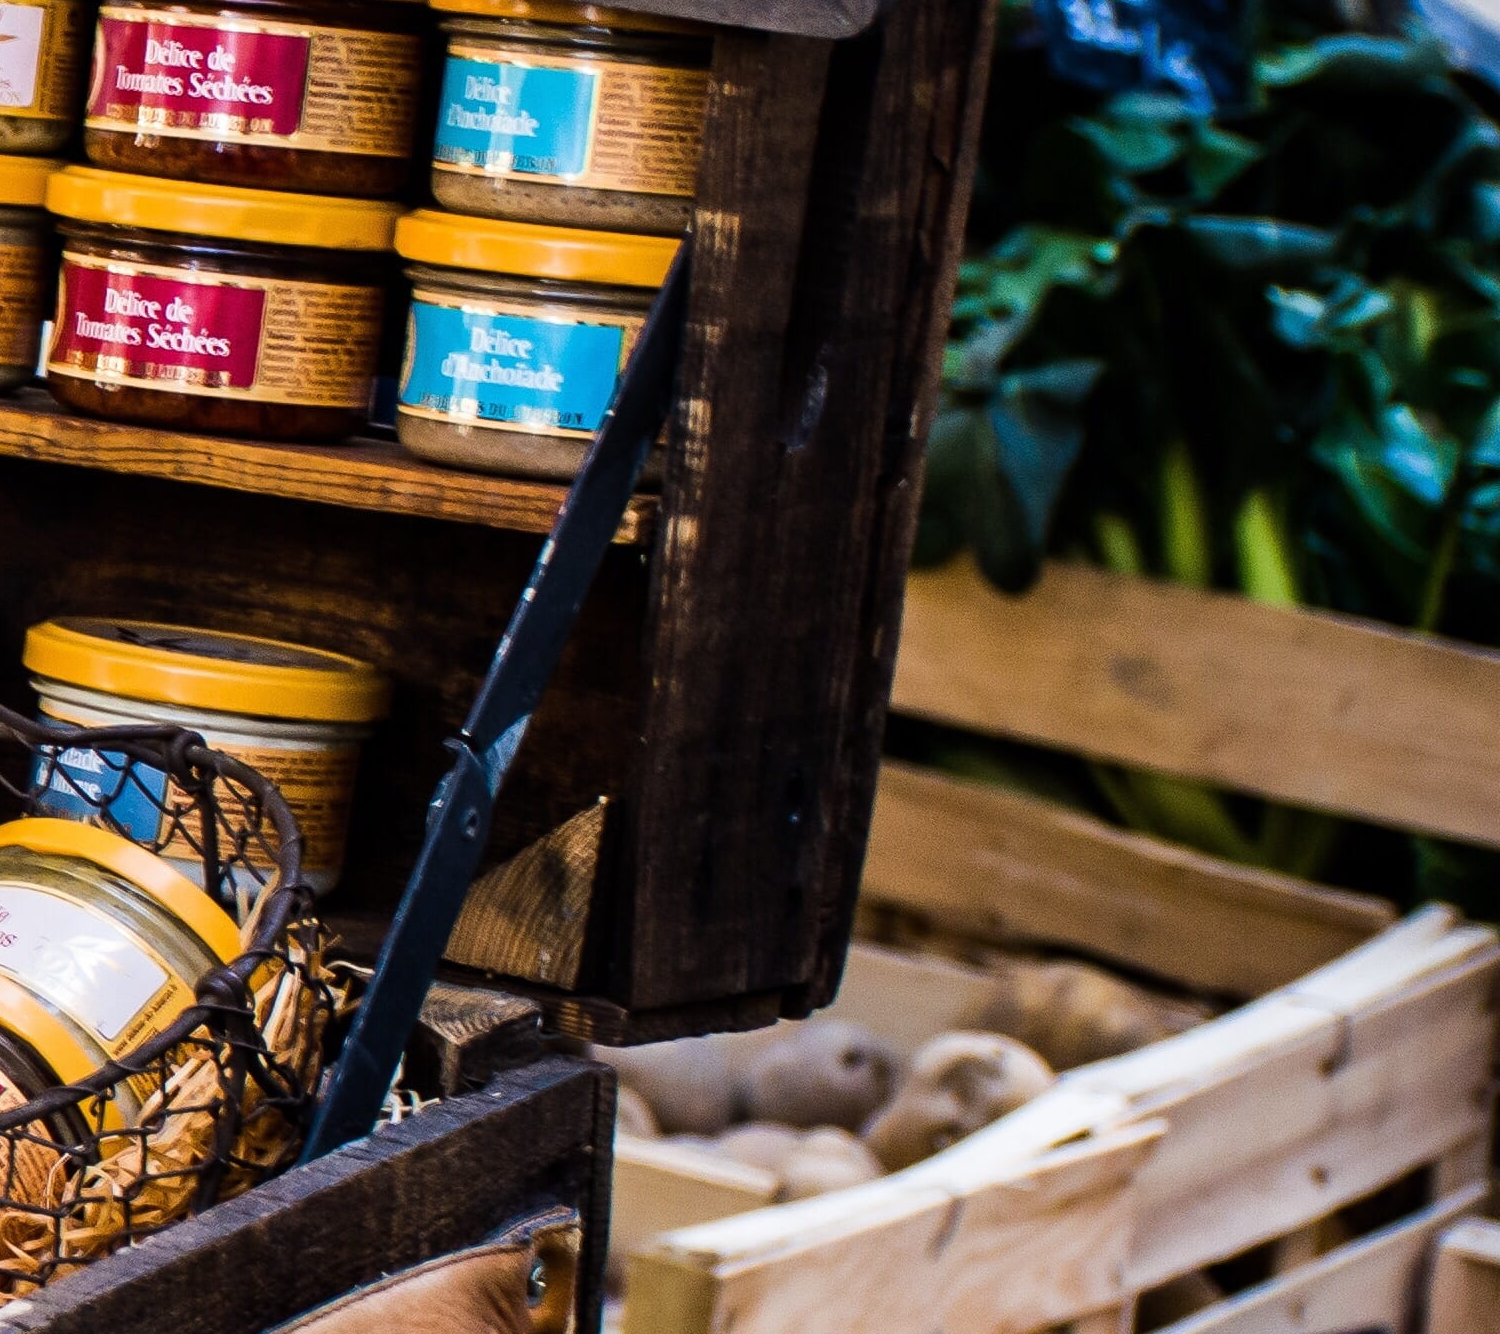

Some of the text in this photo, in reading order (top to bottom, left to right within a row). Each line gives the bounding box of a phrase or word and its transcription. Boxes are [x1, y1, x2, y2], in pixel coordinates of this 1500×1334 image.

[105, 287, 193, 322] Délice de
[76, 311, 230, 357] Tomates Séchées
[471, 327, 533, 359] Délice
